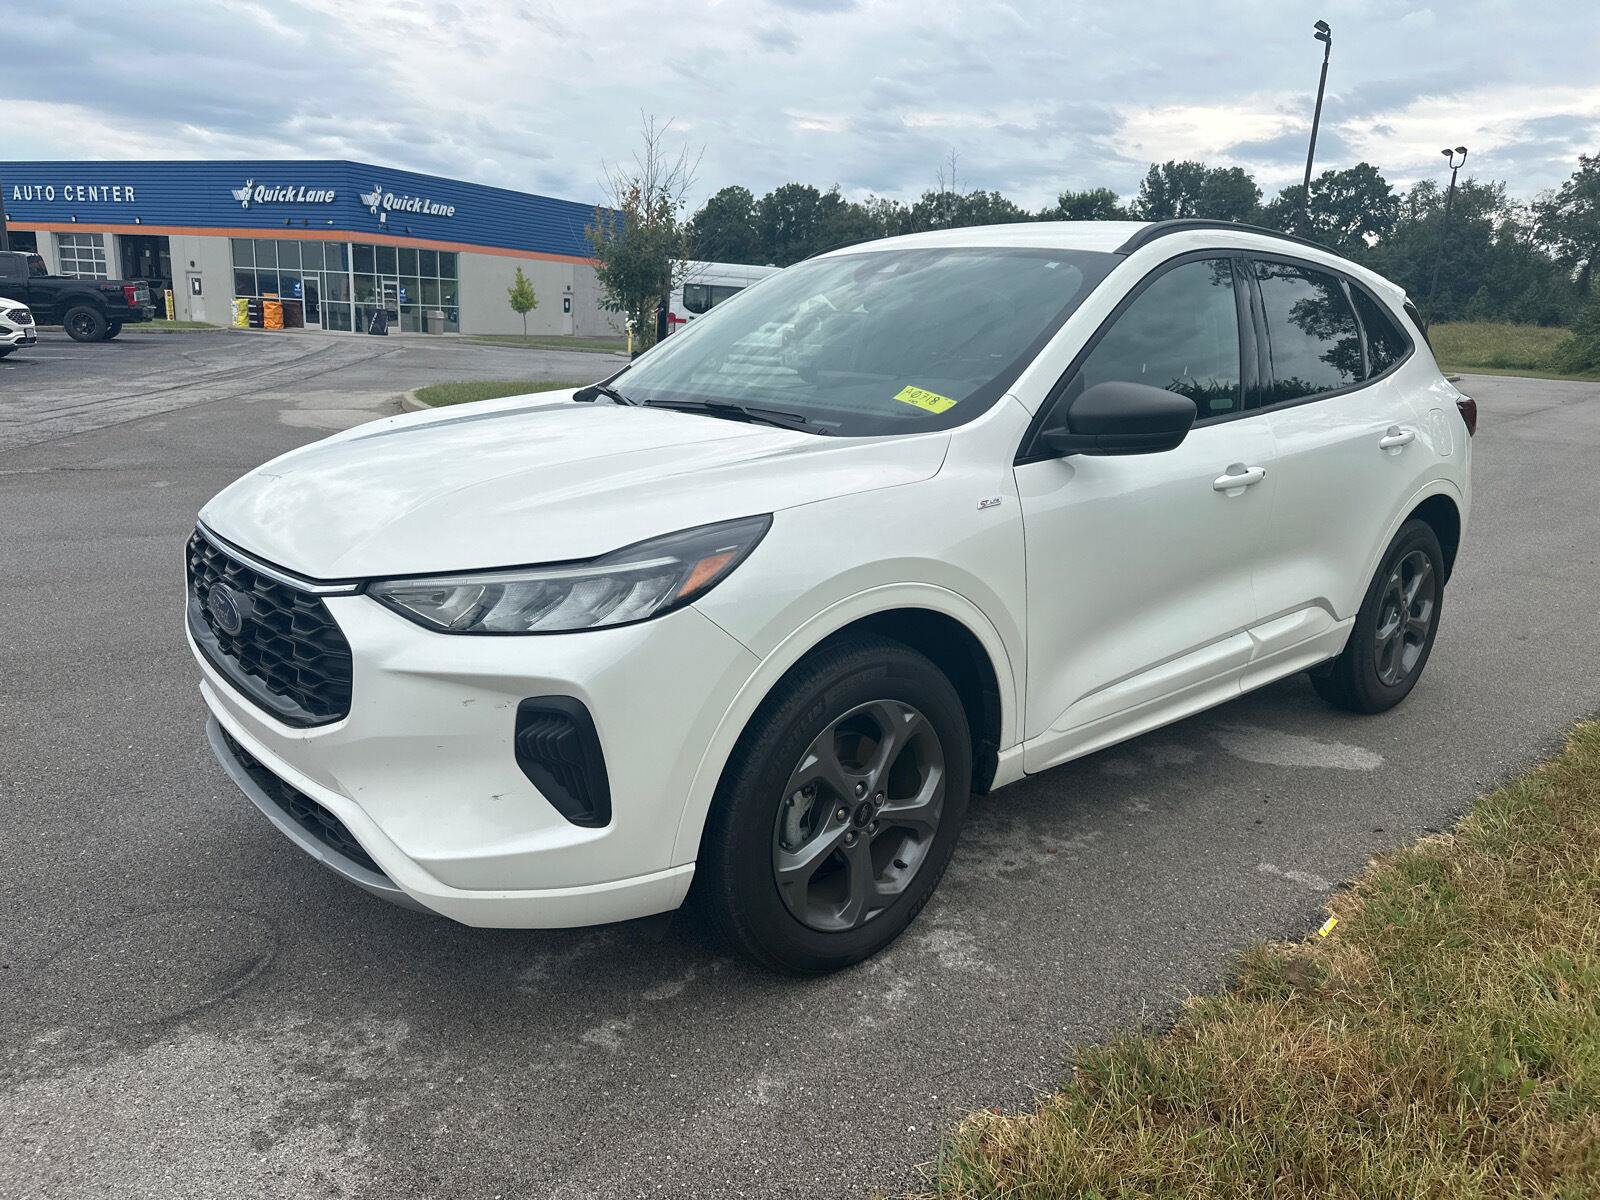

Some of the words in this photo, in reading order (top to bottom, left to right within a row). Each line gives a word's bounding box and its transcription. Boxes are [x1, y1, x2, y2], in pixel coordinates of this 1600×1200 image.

[13, 185, 55, 201] AUTO
[64, 185, 135, 202] CENTER
[254, 185, 296, 203] Quick
[297, 186, 335, 203] Lane
[383, 193, 422, 212] Quick
[423, 199, 455, 217] Lane
